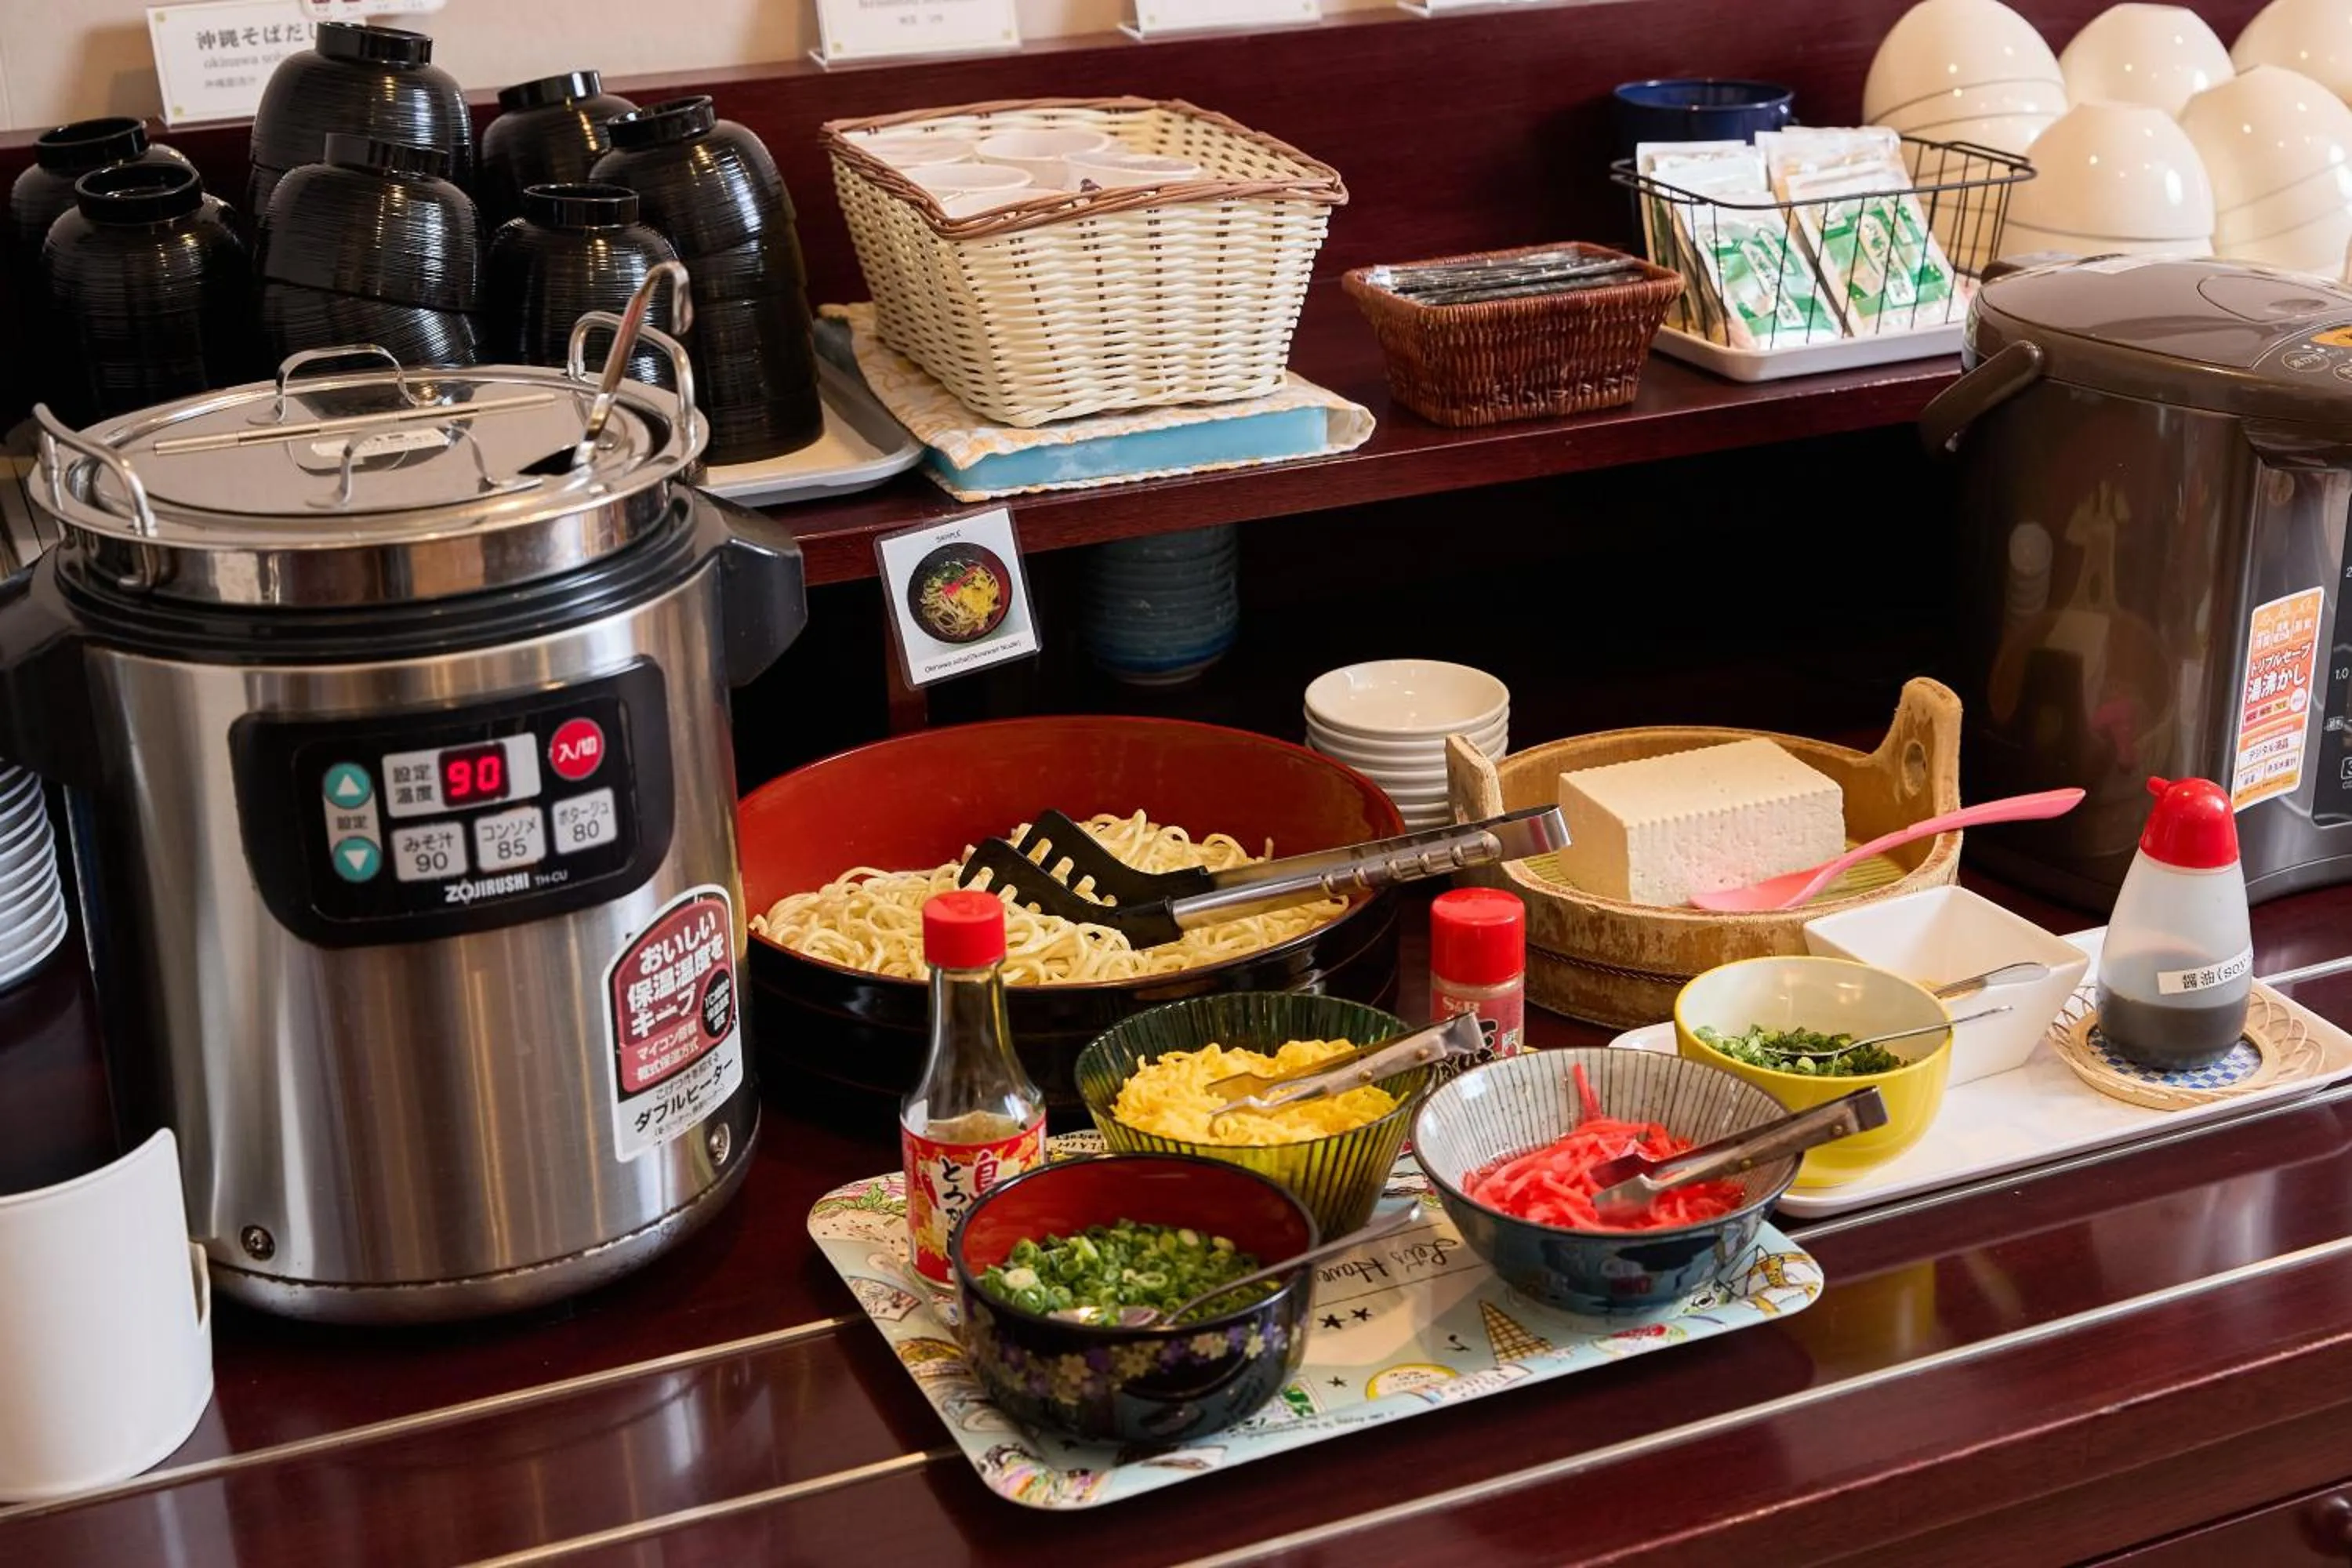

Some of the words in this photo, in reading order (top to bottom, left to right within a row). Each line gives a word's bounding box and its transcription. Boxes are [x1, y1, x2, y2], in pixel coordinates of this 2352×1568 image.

[394, 764, 433, 784] 設定
[446, 756, 501, 797] 90
[395, 785, 434, 805] 温度
[336, 814, 368, 830] 設定
[481, 816, 537, 842] コンソメ
[573, 820, 600, 843] 80
[404, 832, 454, 851] みそ汁
[497, 840, 528, 860] 85
[416, 852, 448, 872] 90
[445, 873, 530, 904] ZOJIRUSHI
[640, 911, 717, 974] おいしい
[631, 982, 696, 1038] キープ
[634, 1058, 733, 1133] ダブルヒーター
